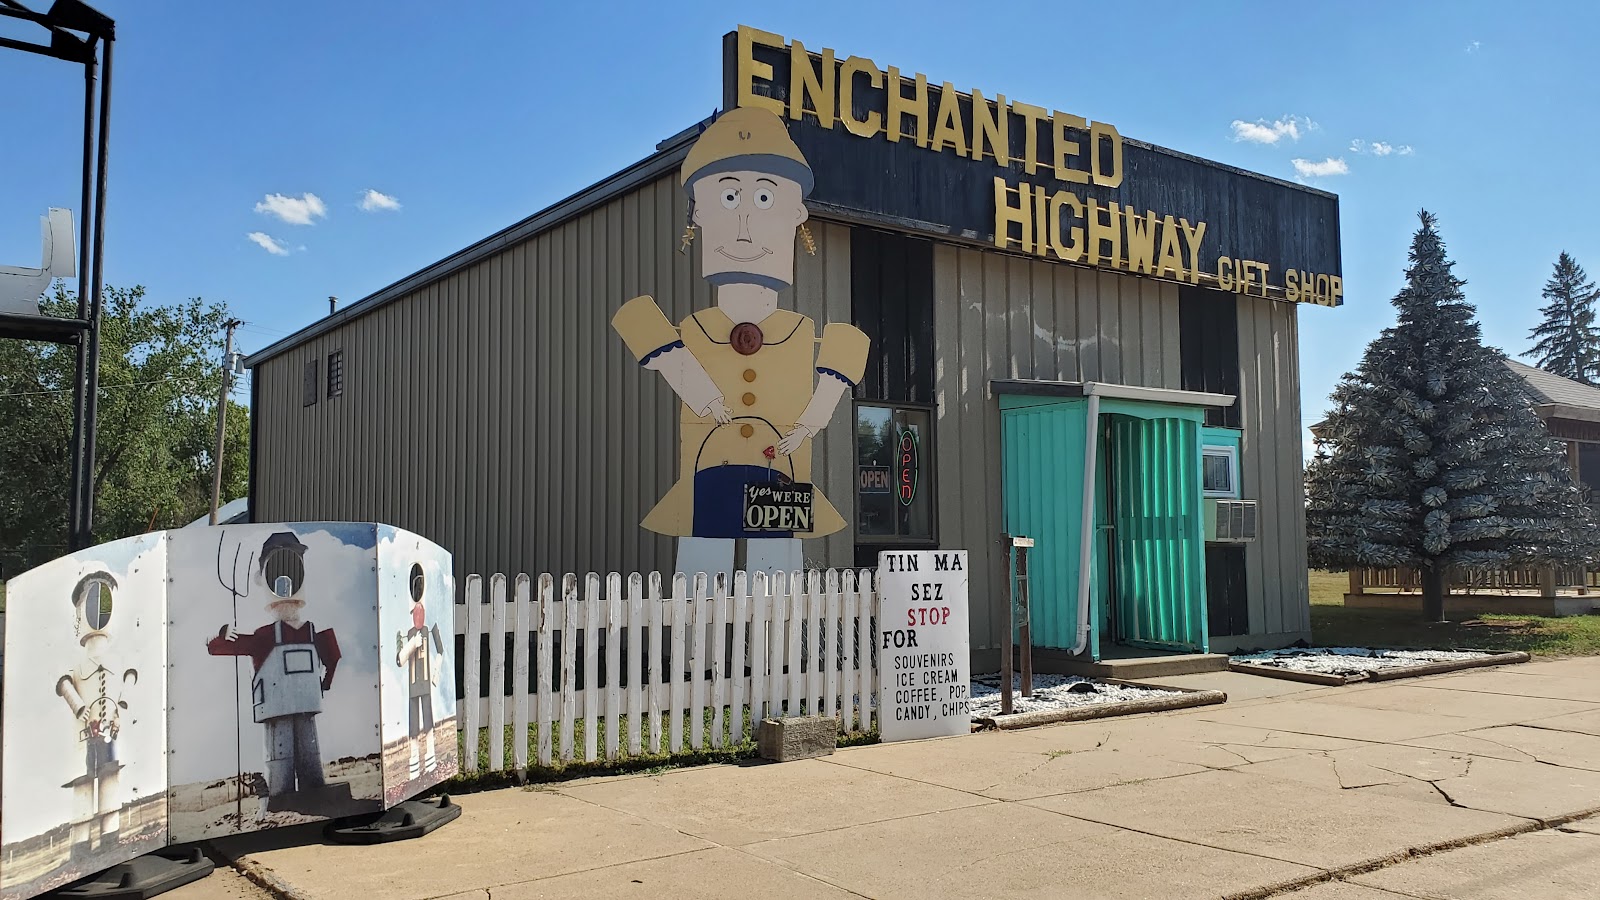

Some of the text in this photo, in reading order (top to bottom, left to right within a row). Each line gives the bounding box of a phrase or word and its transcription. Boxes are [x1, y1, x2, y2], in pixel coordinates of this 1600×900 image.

[737, 25, 1124, 188] ENCHANTED
[994, 177, 1207, 285] HIGHWAY
[1217, 255, 1343, 308] GIFT SHOP
[902, 437, 912, 498] OPEN
[860, 470, 888, 489] OPEN
[746, 505, 810, 529] OPEN
[886, 553, 963, 573] TIN MA
[911, 583, 944, 601] SEZ
[907, 606, 951, 627] STOP
[882, 629, 919, 650] FOR
[894, 652, 954, 670] SOUVENIRS
[896, 669, 958, 687] ICE CREAM
[942, 701, 970, 717] CHIPS
